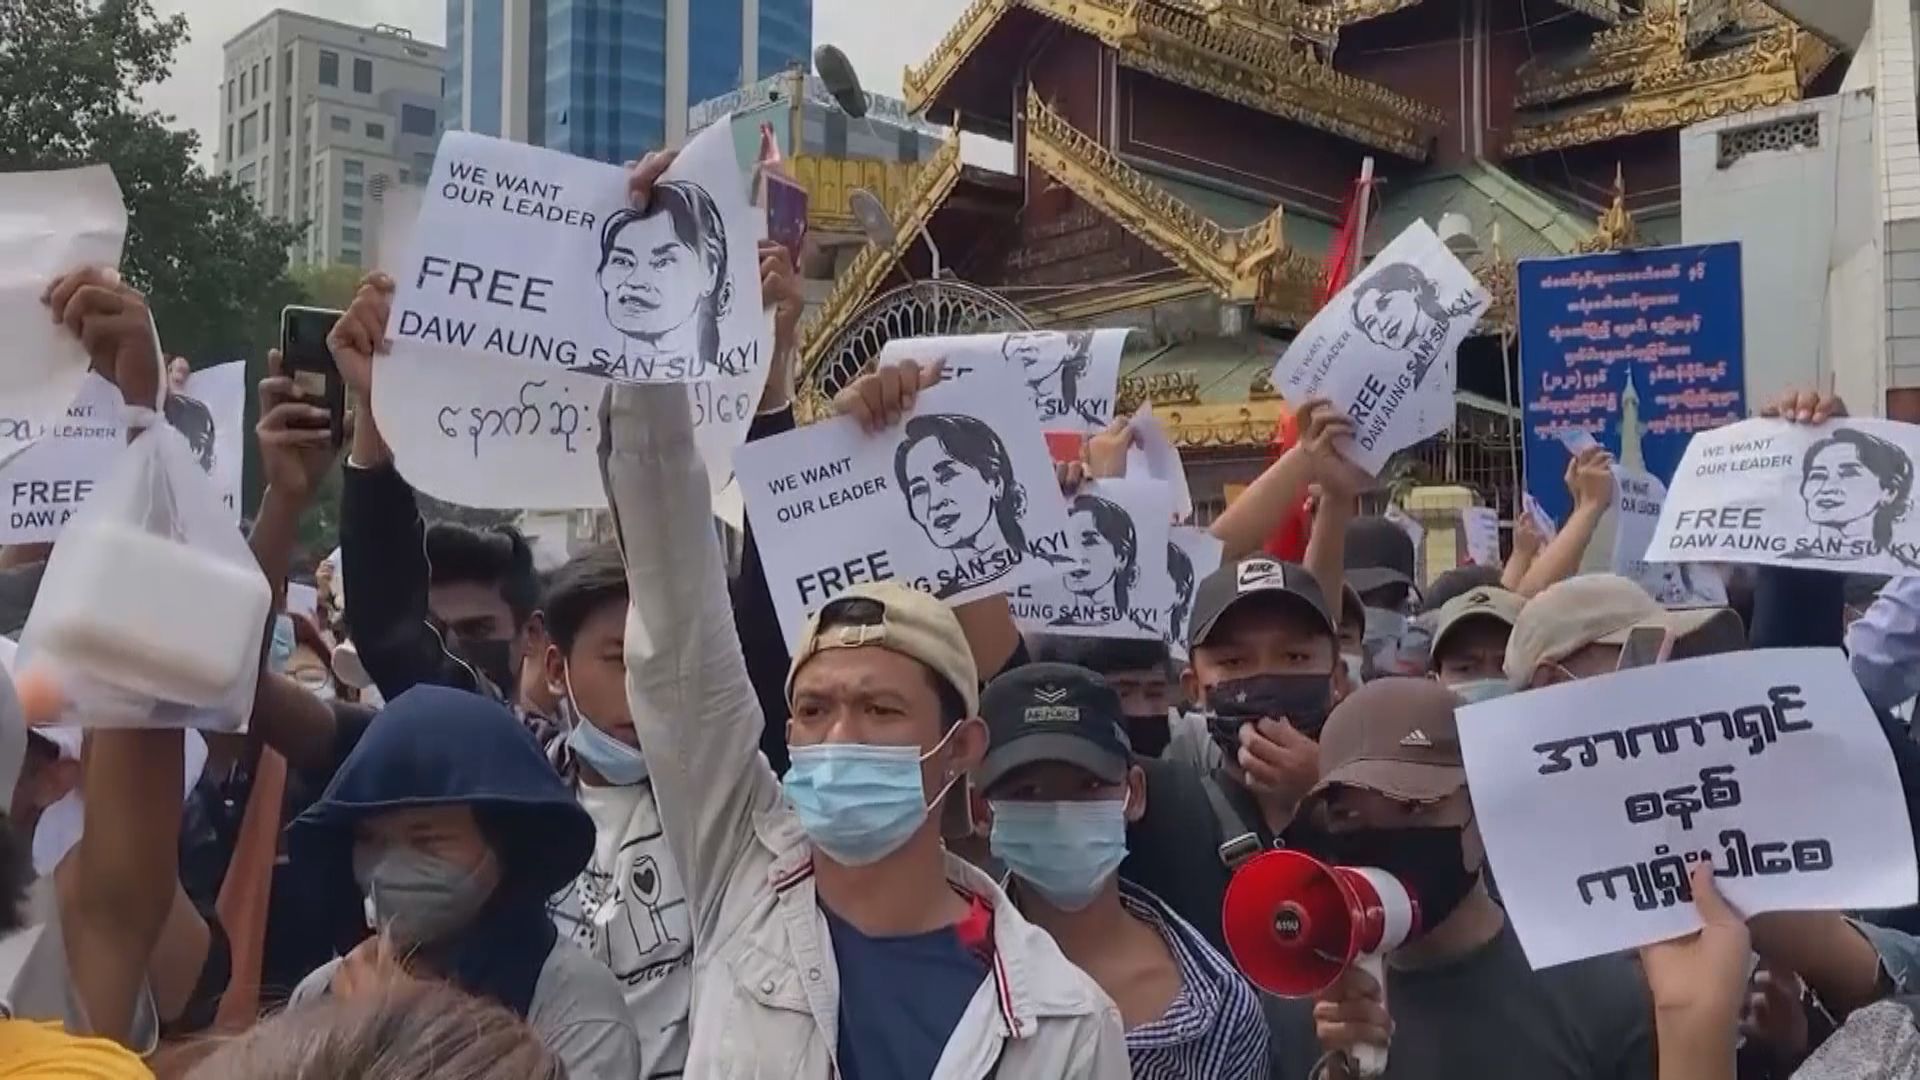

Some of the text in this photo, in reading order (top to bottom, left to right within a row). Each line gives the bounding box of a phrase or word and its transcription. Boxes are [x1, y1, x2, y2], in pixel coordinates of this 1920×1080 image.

[448, 161, 564, 201] WE WANT
[442, 182, 596, 231] OUR LEADER
[416, 256, 554, 313] FREE
[398, 311, 758, 379] DAW AUNG SAN SU KYI
[1320, 331, 1351, 375] LEADER
[1360, 414, 1387, 451] DAW
[1386, 376, 1412, 420] AUNG
[1406, 339, 1438, 376] SAN
[1449, 289, 1474, 317] KYI
[66, 405, 94, 418] ANT
[1077, 399, 1107, 415] KYI
[1347, 374, 1387, 425] REE
[53, 426, 116, 438] LEADER
[1702, 438, 1774, 458] WE WANT
[768, 458, 852, 496] WE WANT
[1696, 455, 1793, 477] OUR LEADER
[11, 509, 56, 529] DAW
[777, 477, 888, 523] OUR LEADER
[1675, 507, 1766, 530] FREE
[937, 557, 986, 588] SAN
[993, 549, 1022, 571] SU
[1029, 530, 1069, 559] KYI
[1669, 534, 1920, 559] DAW AUNG SAN SU KY
[796, 550, 894, 605] FREE
[1245, 562, 1274, 573] NIKE
[1008, 604, 1157, 622] AUNG SAN SU KYI
[1532, 685, 1813, 775] အာဏာရှင်
[1624, 764, 1743, 829] စနစ်
